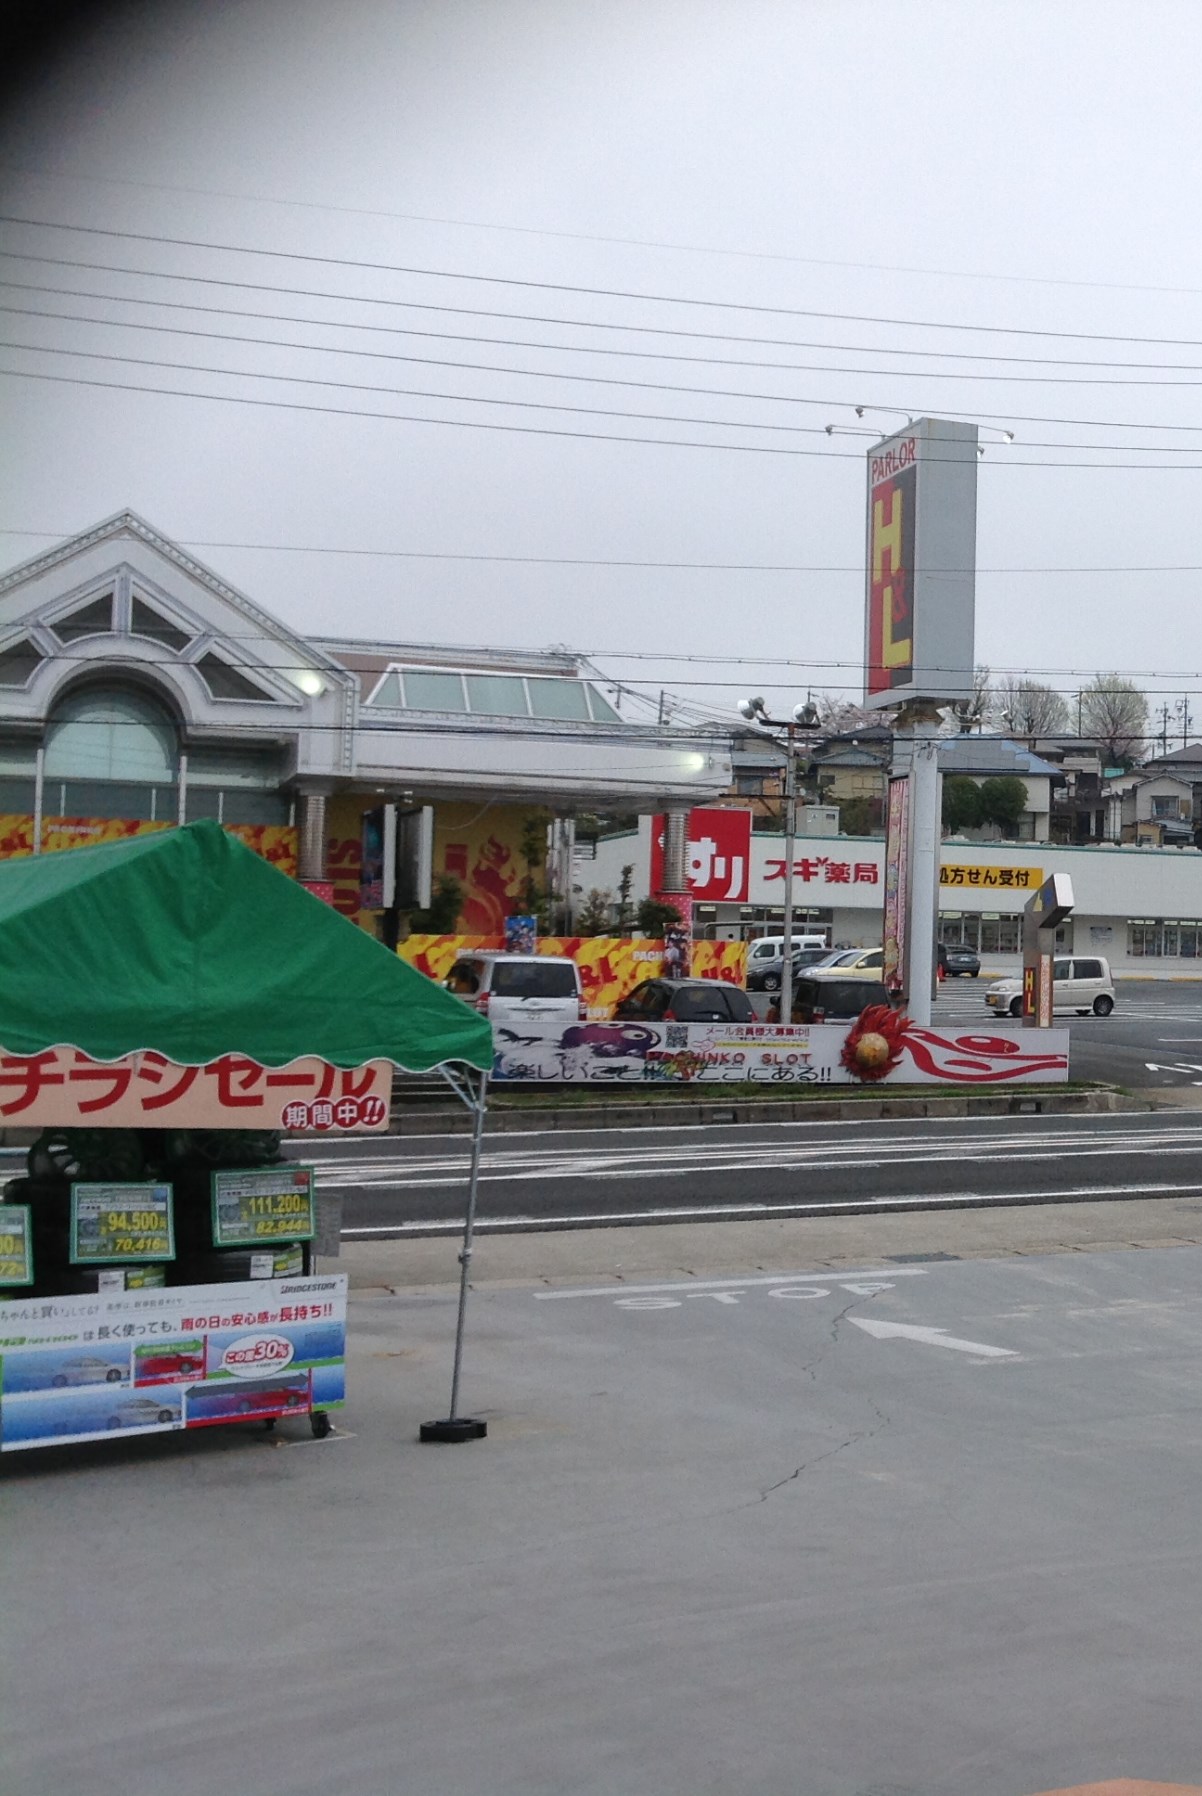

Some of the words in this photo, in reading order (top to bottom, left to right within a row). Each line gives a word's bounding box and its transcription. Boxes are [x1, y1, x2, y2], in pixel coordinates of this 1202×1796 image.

[872, 436, 915, 484] PARLOR
[763, 857, 878, 884] スギ薬局
[762, 1053, 812, 1065] SLOT
[286, 1100, 381, 1128] 期間中!!
[280, 1282, 337, 1295] BRIDGESTONE
[613, 1282, 896, 1310] STOP
